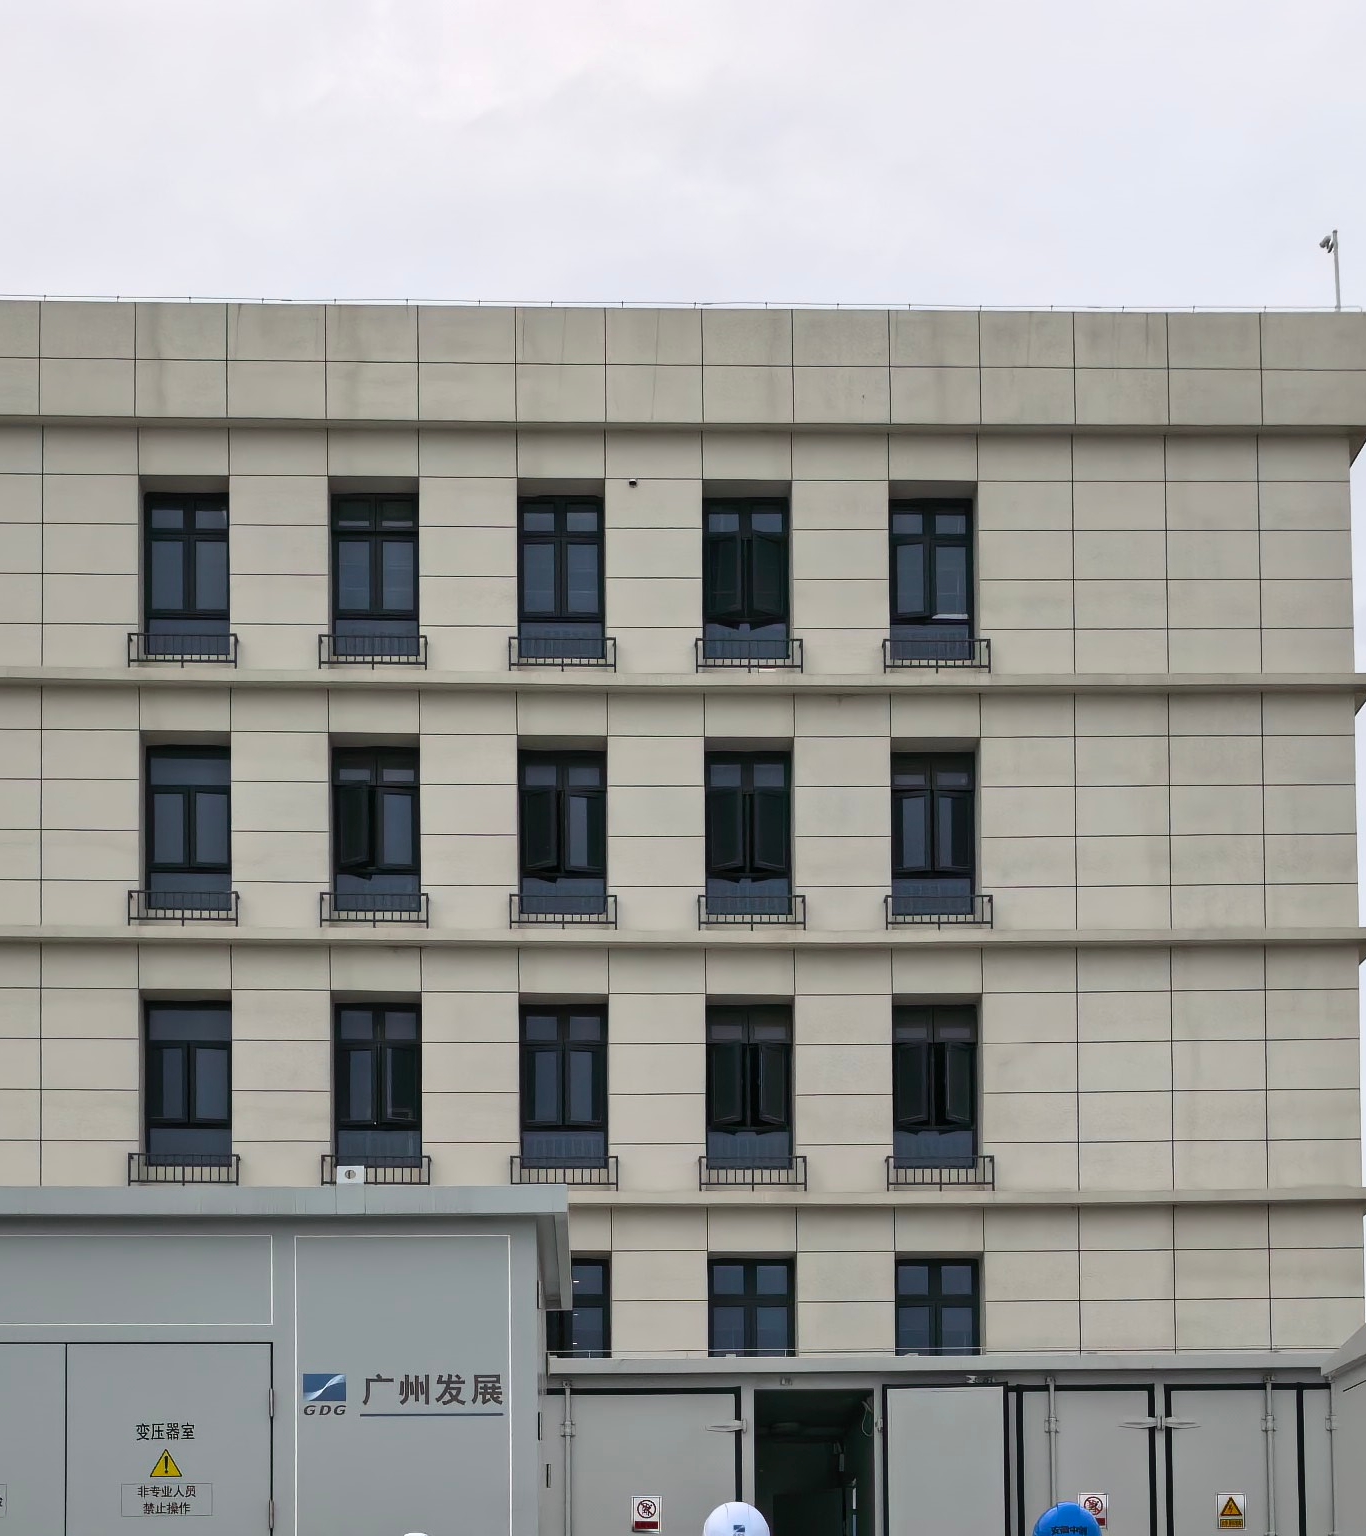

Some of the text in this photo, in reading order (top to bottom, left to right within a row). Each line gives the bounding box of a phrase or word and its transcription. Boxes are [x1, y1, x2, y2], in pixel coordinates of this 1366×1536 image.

[362, 1373, 503, 1406] 广州发展
[303, 1405, 346, 1416] GDG
[136, 1422, 195, 1441] 变压器室
[137, 1485, 196, 1498] 非专业人员
[143, 1502, 191, 1515] 禁止操作
